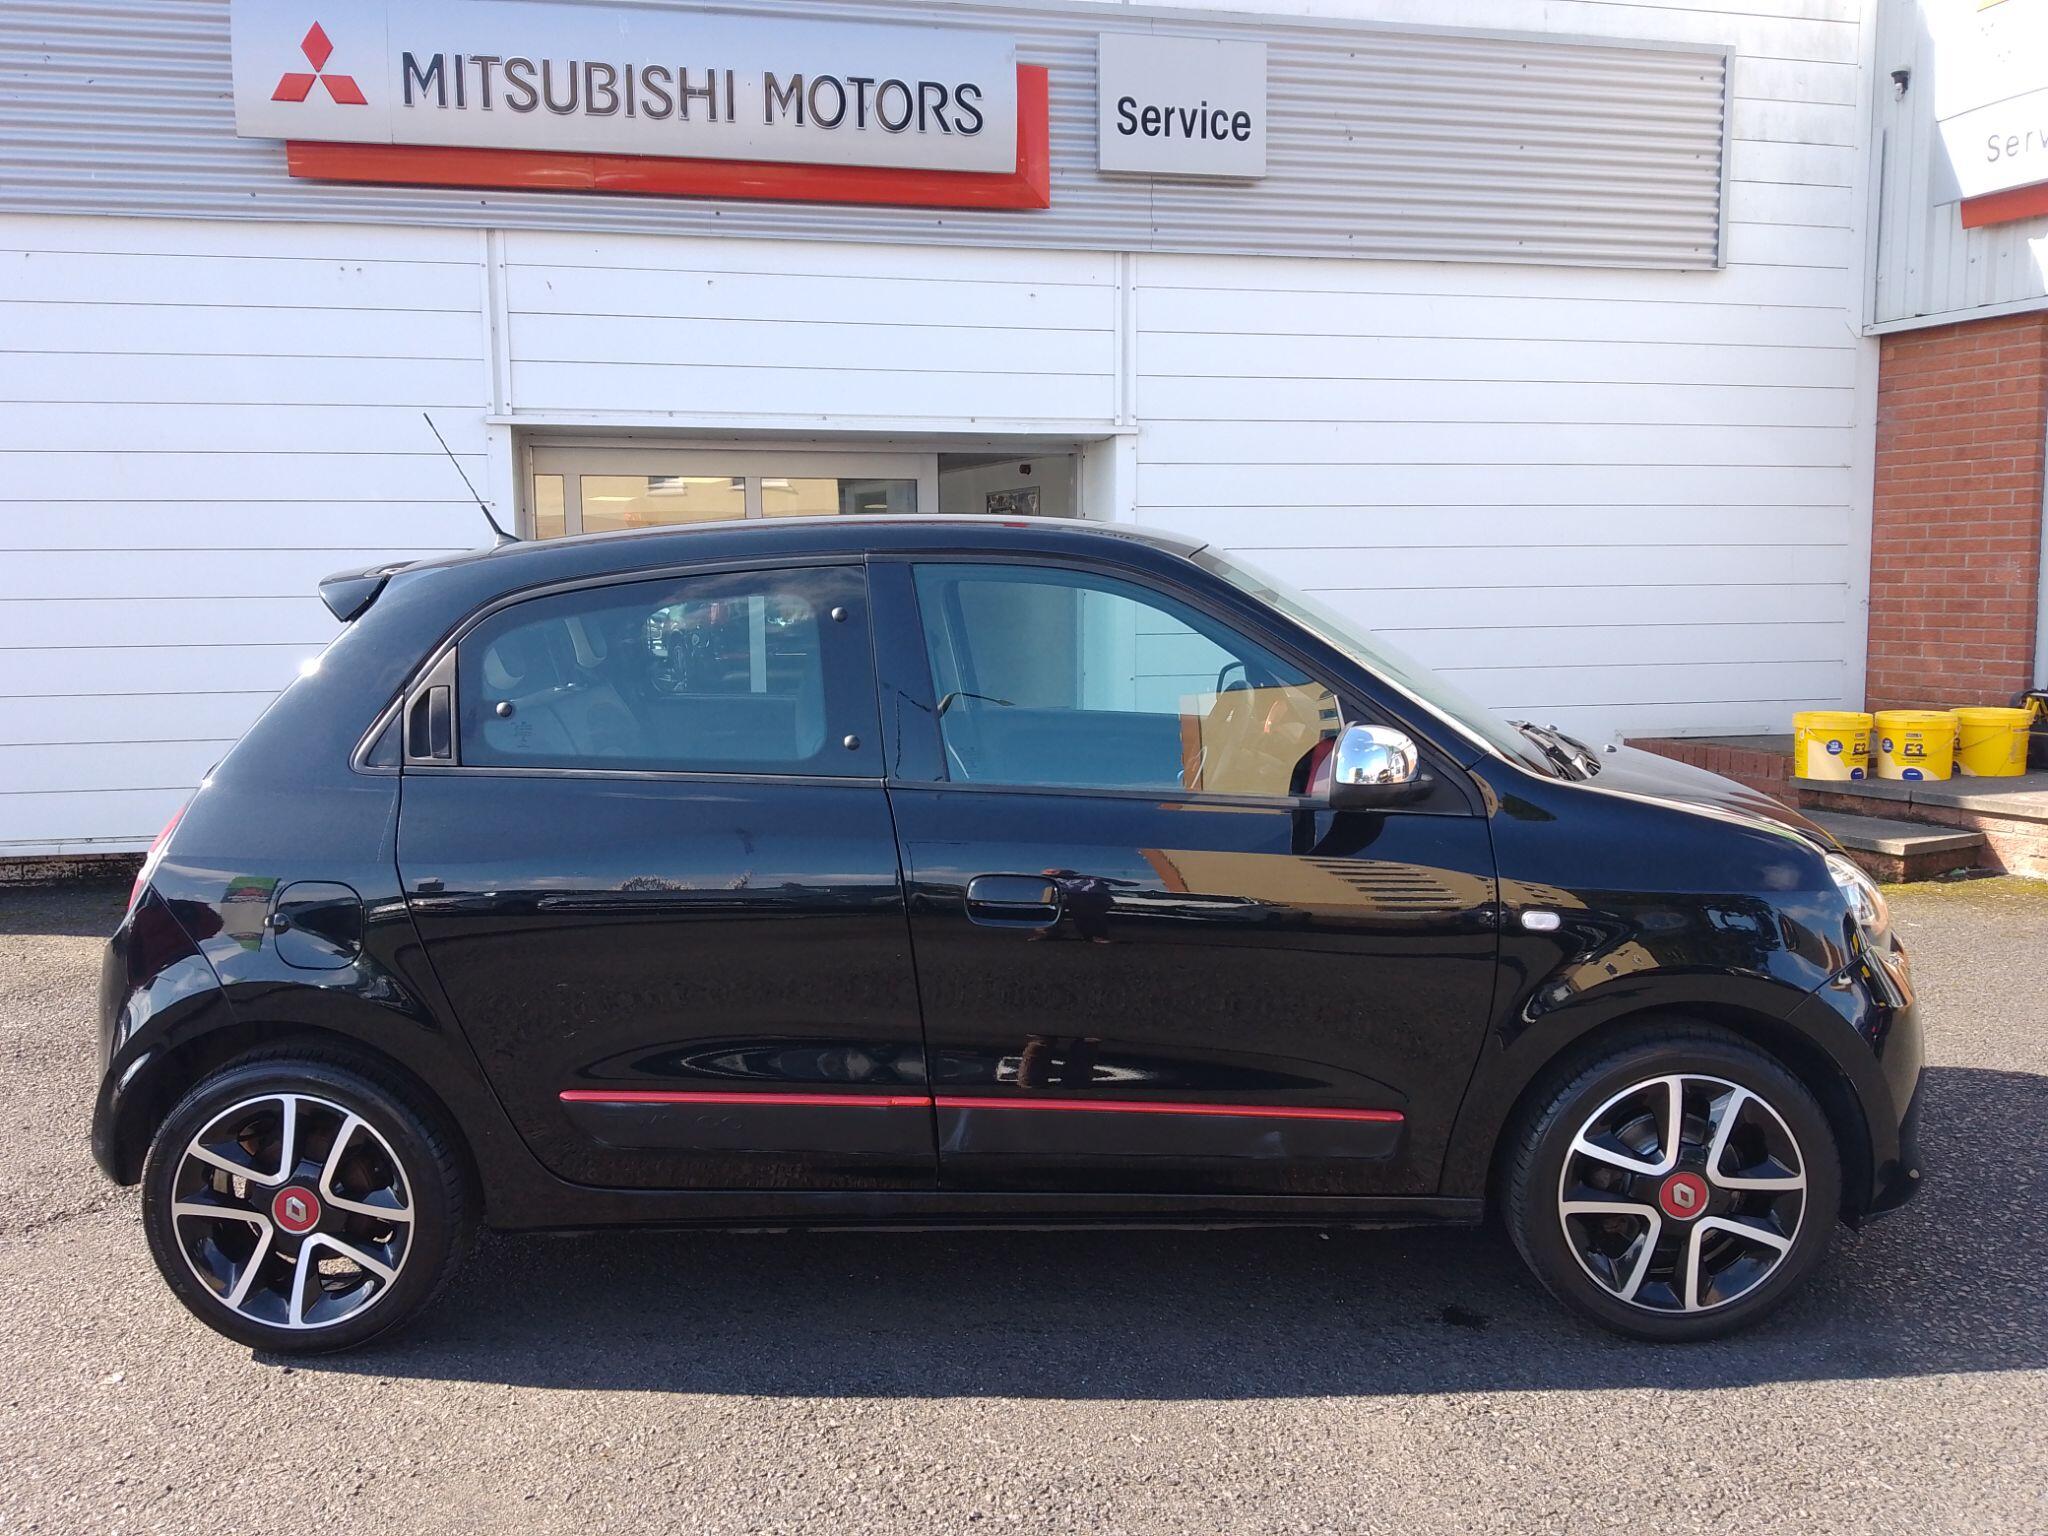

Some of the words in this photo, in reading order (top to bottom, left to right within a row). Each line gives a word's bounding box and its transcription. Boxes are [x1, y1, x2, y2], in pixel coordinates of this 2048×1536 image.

[401, 50, 736, 124] MITSUBISHI
[763, 71, 985, 136] MOTORS
[1117, 96, 1251, 141] Service
[1987, 128, 2048, 162] Serv
[1903, 743, 1925, 755] E3
